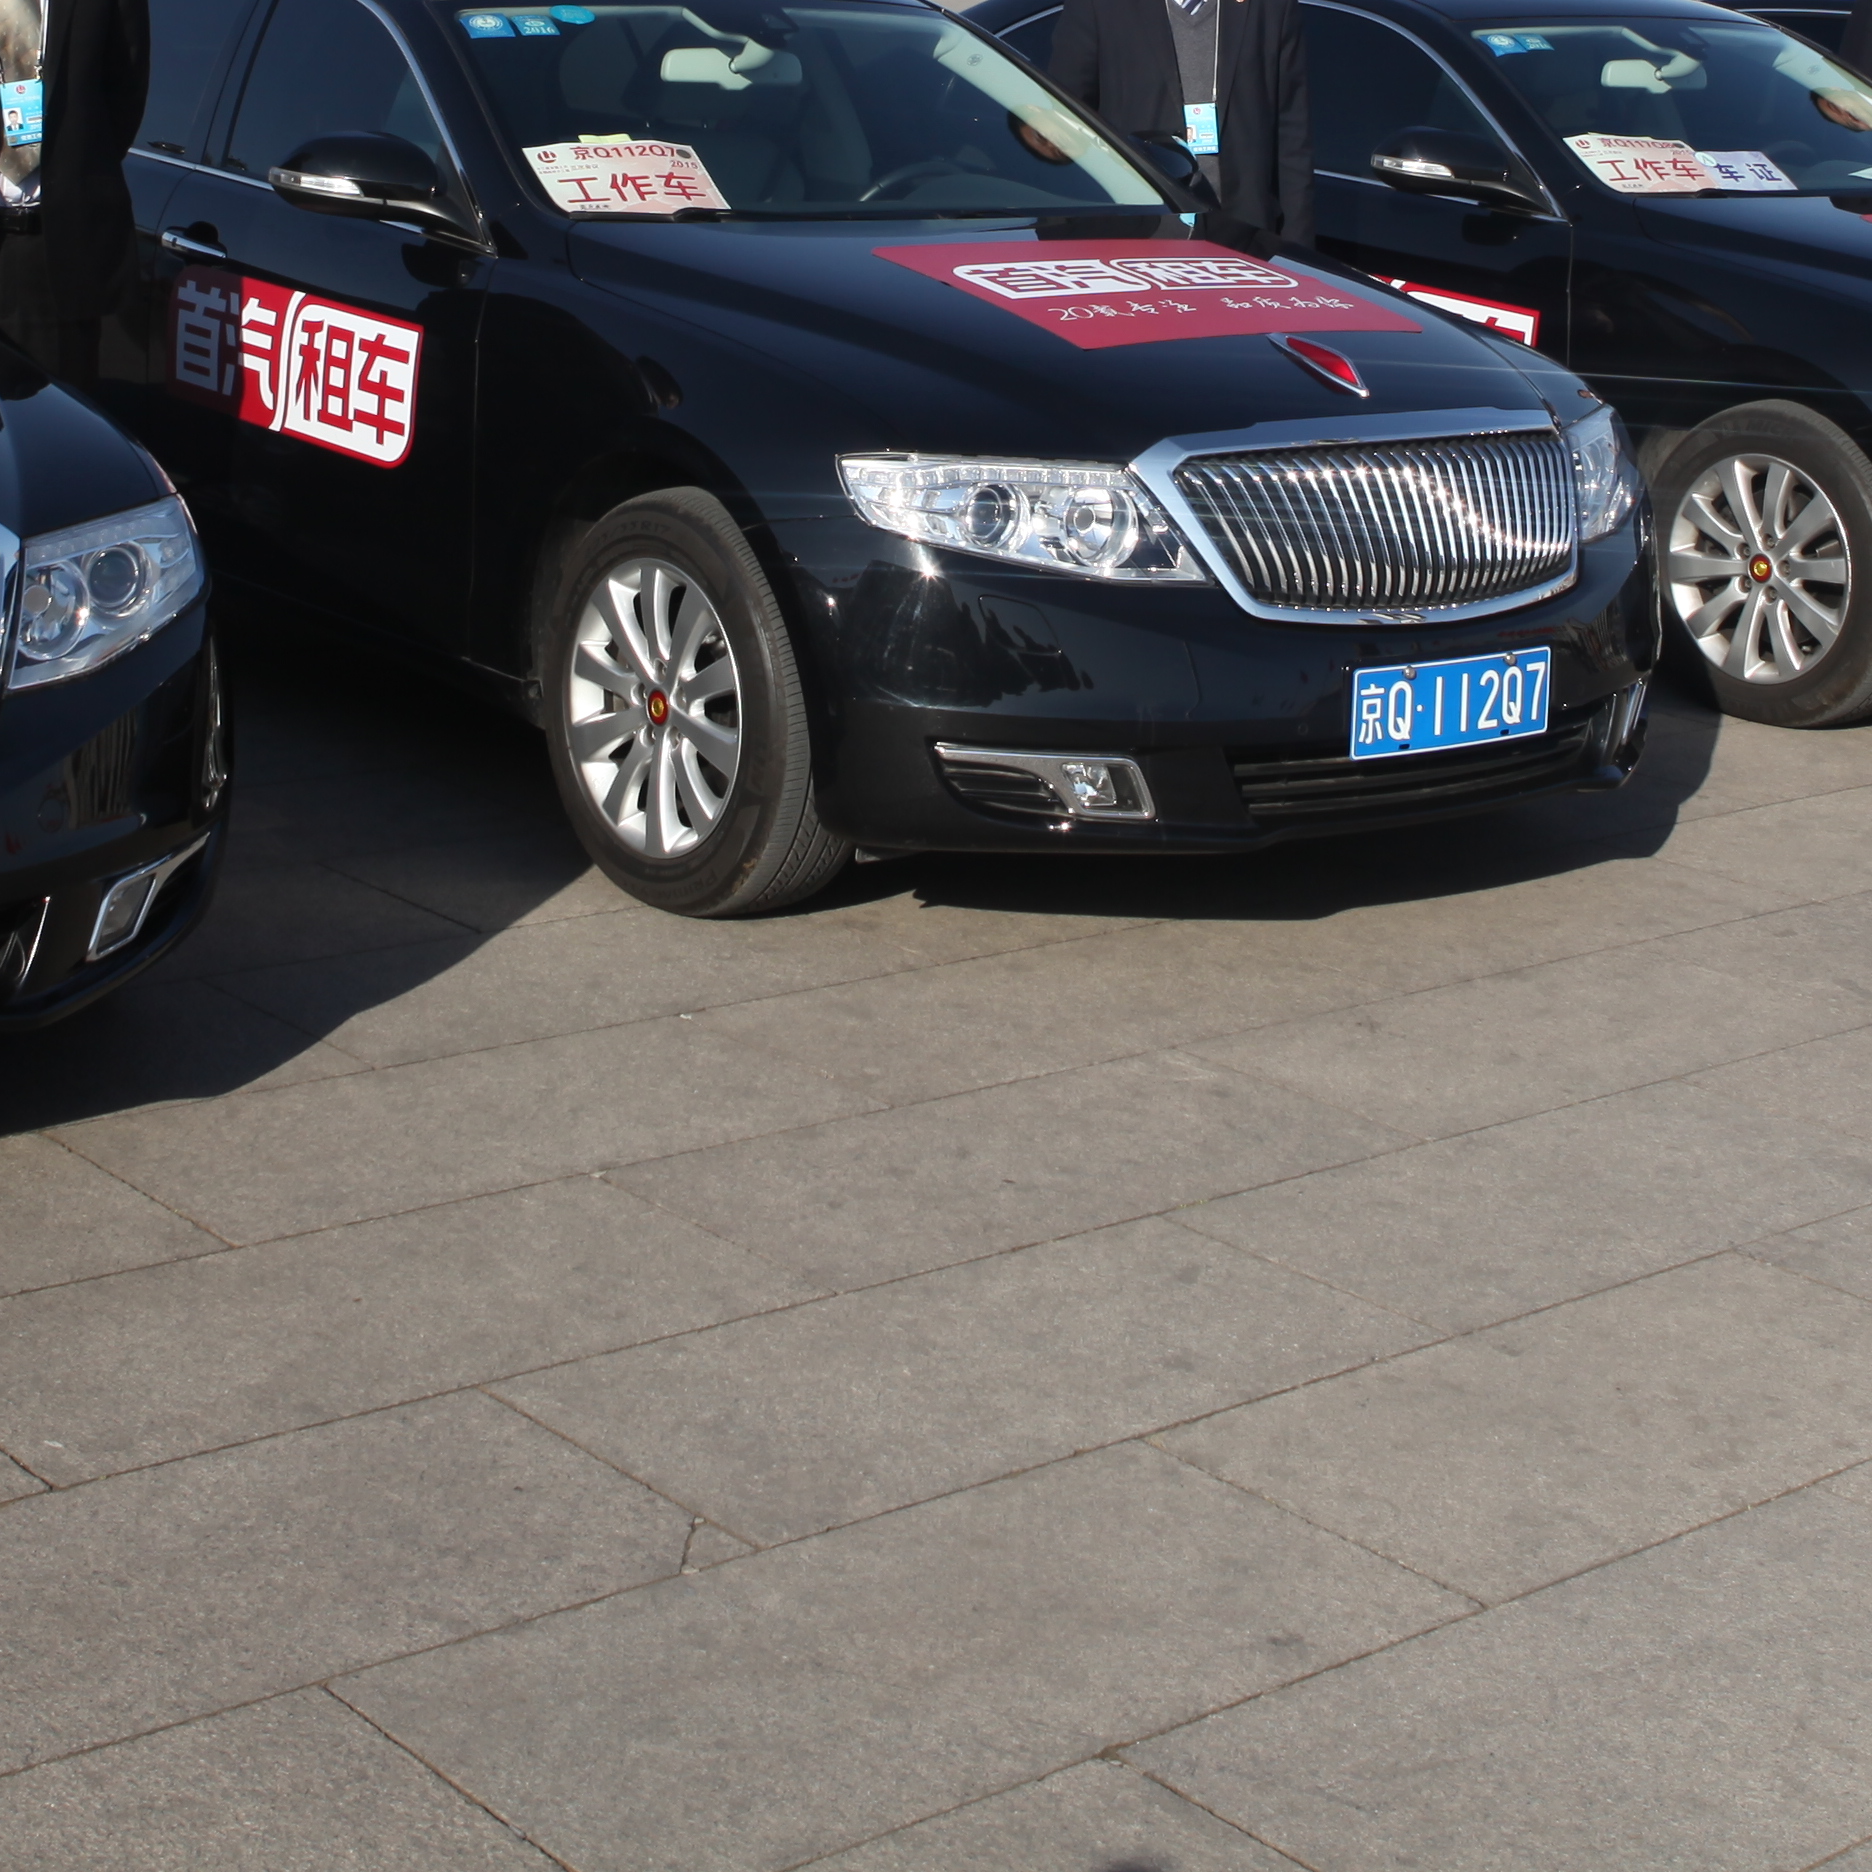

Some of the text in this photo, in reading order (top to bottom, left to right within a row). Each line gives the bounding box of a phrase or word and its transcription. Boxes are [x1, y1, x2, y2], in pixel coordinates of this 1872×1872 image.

[570, 144, 677, 160] 京Q112Q7
[1597, 158, 1705, 181] 工作车
[1715, 162, 1782, 182] 车证
[557, 171, 706, 203] 工作车
[952, 257, 1299, 299] 首汽租车
[175, 279, 420, 463] 首汽租车
[1358, 661, 1546, 745] 京Q·112Q7
